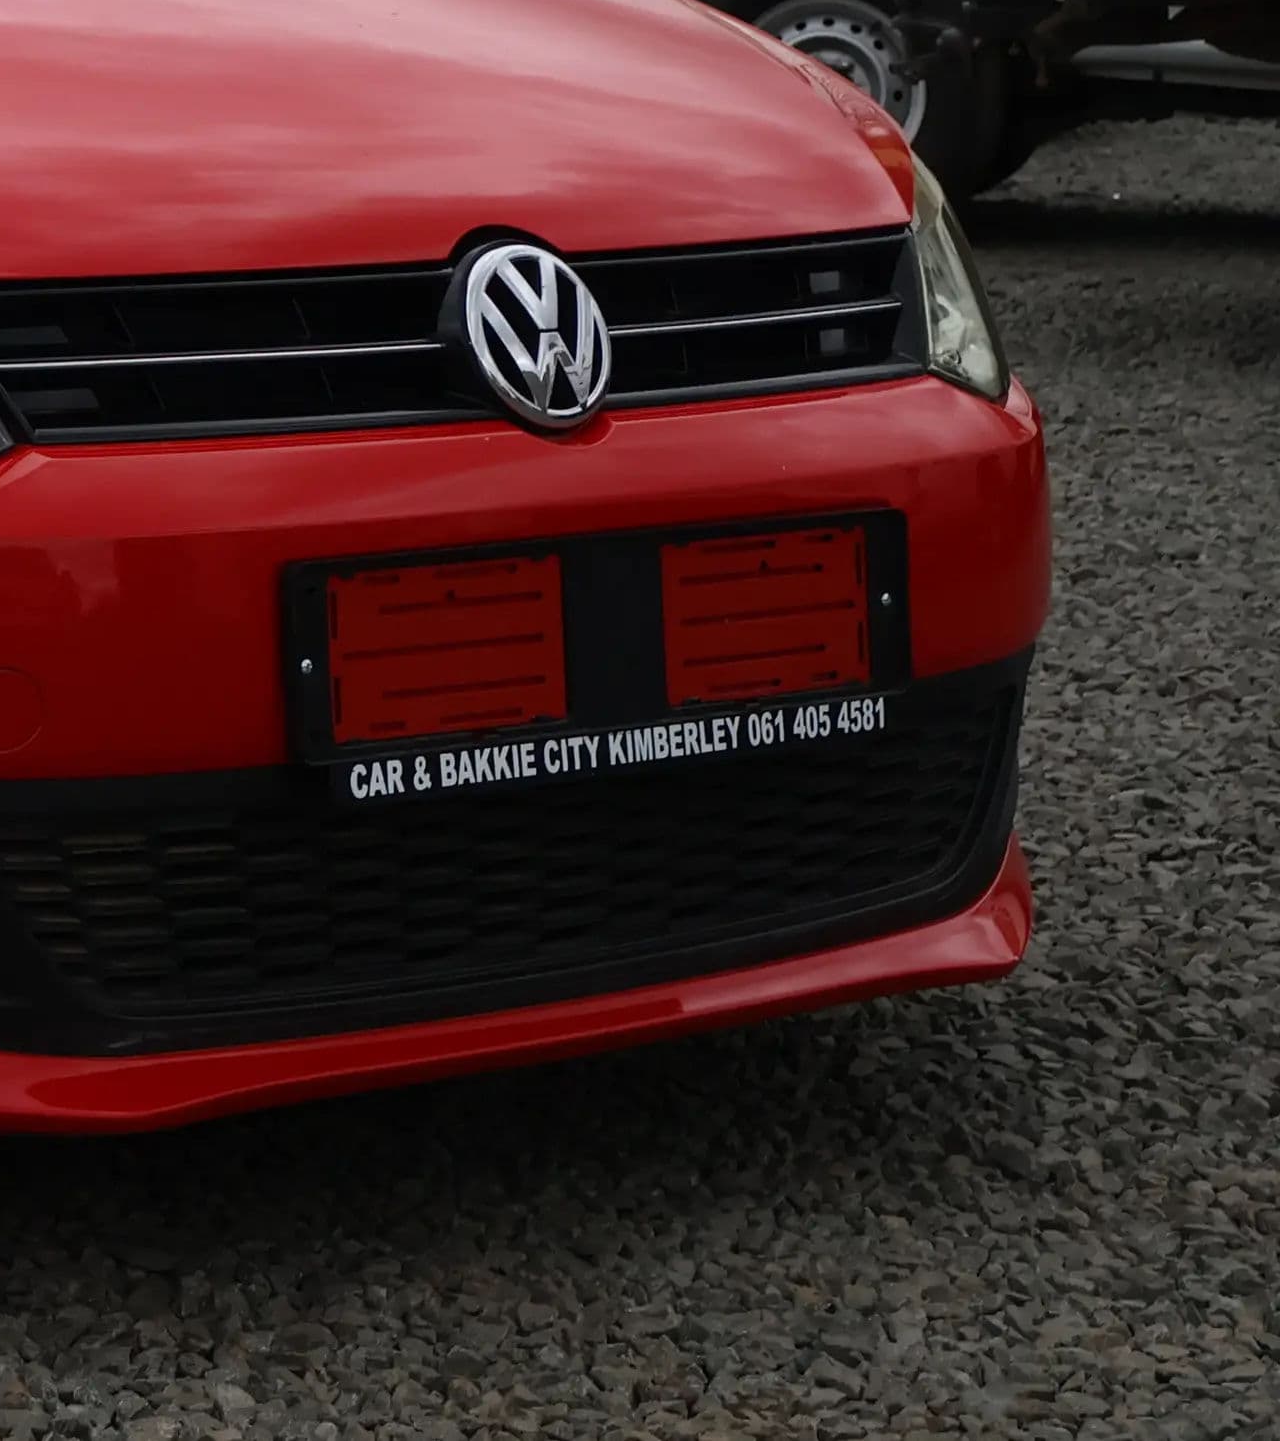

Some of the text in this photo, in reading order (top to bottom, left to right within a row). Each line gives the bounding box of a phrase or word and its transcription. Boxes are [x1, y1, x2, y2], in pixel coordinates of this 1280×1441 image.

[470, 247, 608, 420] VW
[350, 696, 885, 799] CAR & BAKKIE CITY KIMBERLEY 061 405 4581
